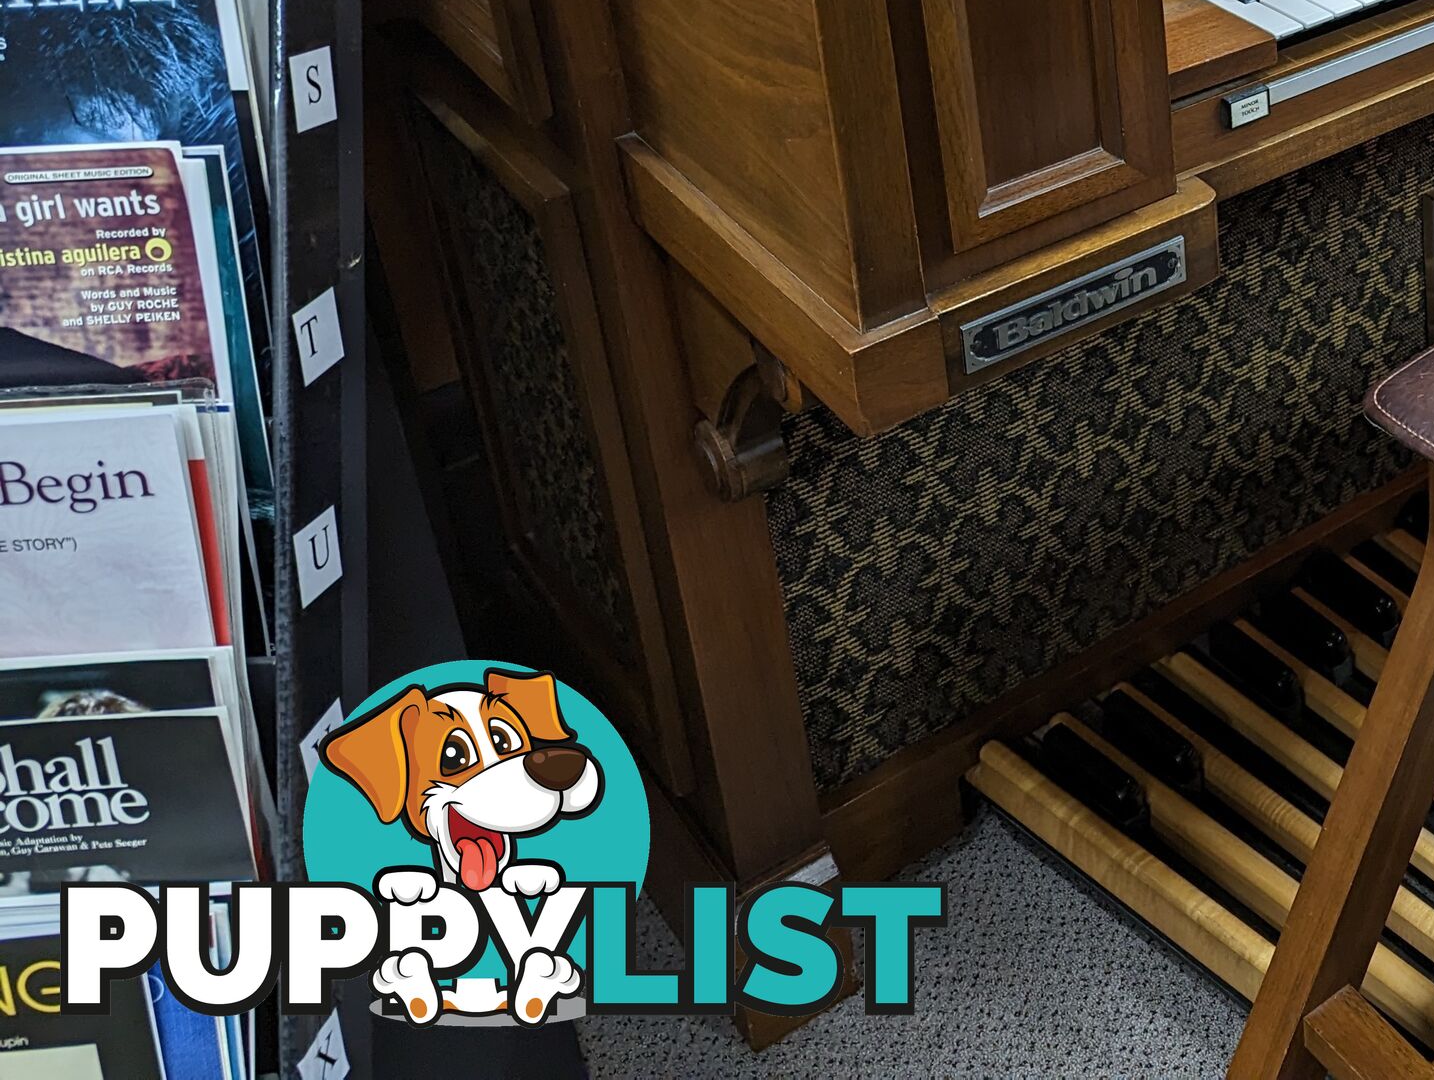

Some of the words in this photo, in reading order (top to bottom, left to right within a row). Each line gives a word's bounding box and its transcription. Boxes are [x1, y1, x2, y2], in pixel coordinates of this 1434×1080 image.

[305, 64, 322, 104] S
[1241, 98, 1259, 110] MINOR
[7, 172, 50, 182] ORIGINAL
[52, 171, 81, 179] SHEET
[83, 168, 112, 178] MUSIC
[114, 166, 150, 176] EDITION
[15, 193, 66, 227] girl
[73, 189, 161, 218] wants
[96, 228, 149, 239] Recorded
[152, 227, 166, 237] by
[61, 243, 142, 267] aguilera
[81, 268, 95, 277] on
[99, 266, 124, 275] RCA
[127, 263, 173, 274] Records
[81, 289, 116, 299] Words
[119, 287, 140, 297] and
[143, 285, 177, 296] Music
[91, 302, 105, 313] by
[107, 301, 134, 311] GUY
[137, 298, 179, 309] ROCHE
[993, 266, 1158, 350] Baldwin
[62, 317, 83, 327] and
[86, 314, 132, 325] SHELLY
[135, 311, 181, 323] PEIKEN
[300, 316, 319, 358] T
[309, 524, 330, 571] U
[0, 736, 129, 796] hall
[15, 835, 69, 847] Adaptation
[70, 834, 83, 844] by
[79, 841, 90, 850] &
[115, 838, 148, 848] Seeger
